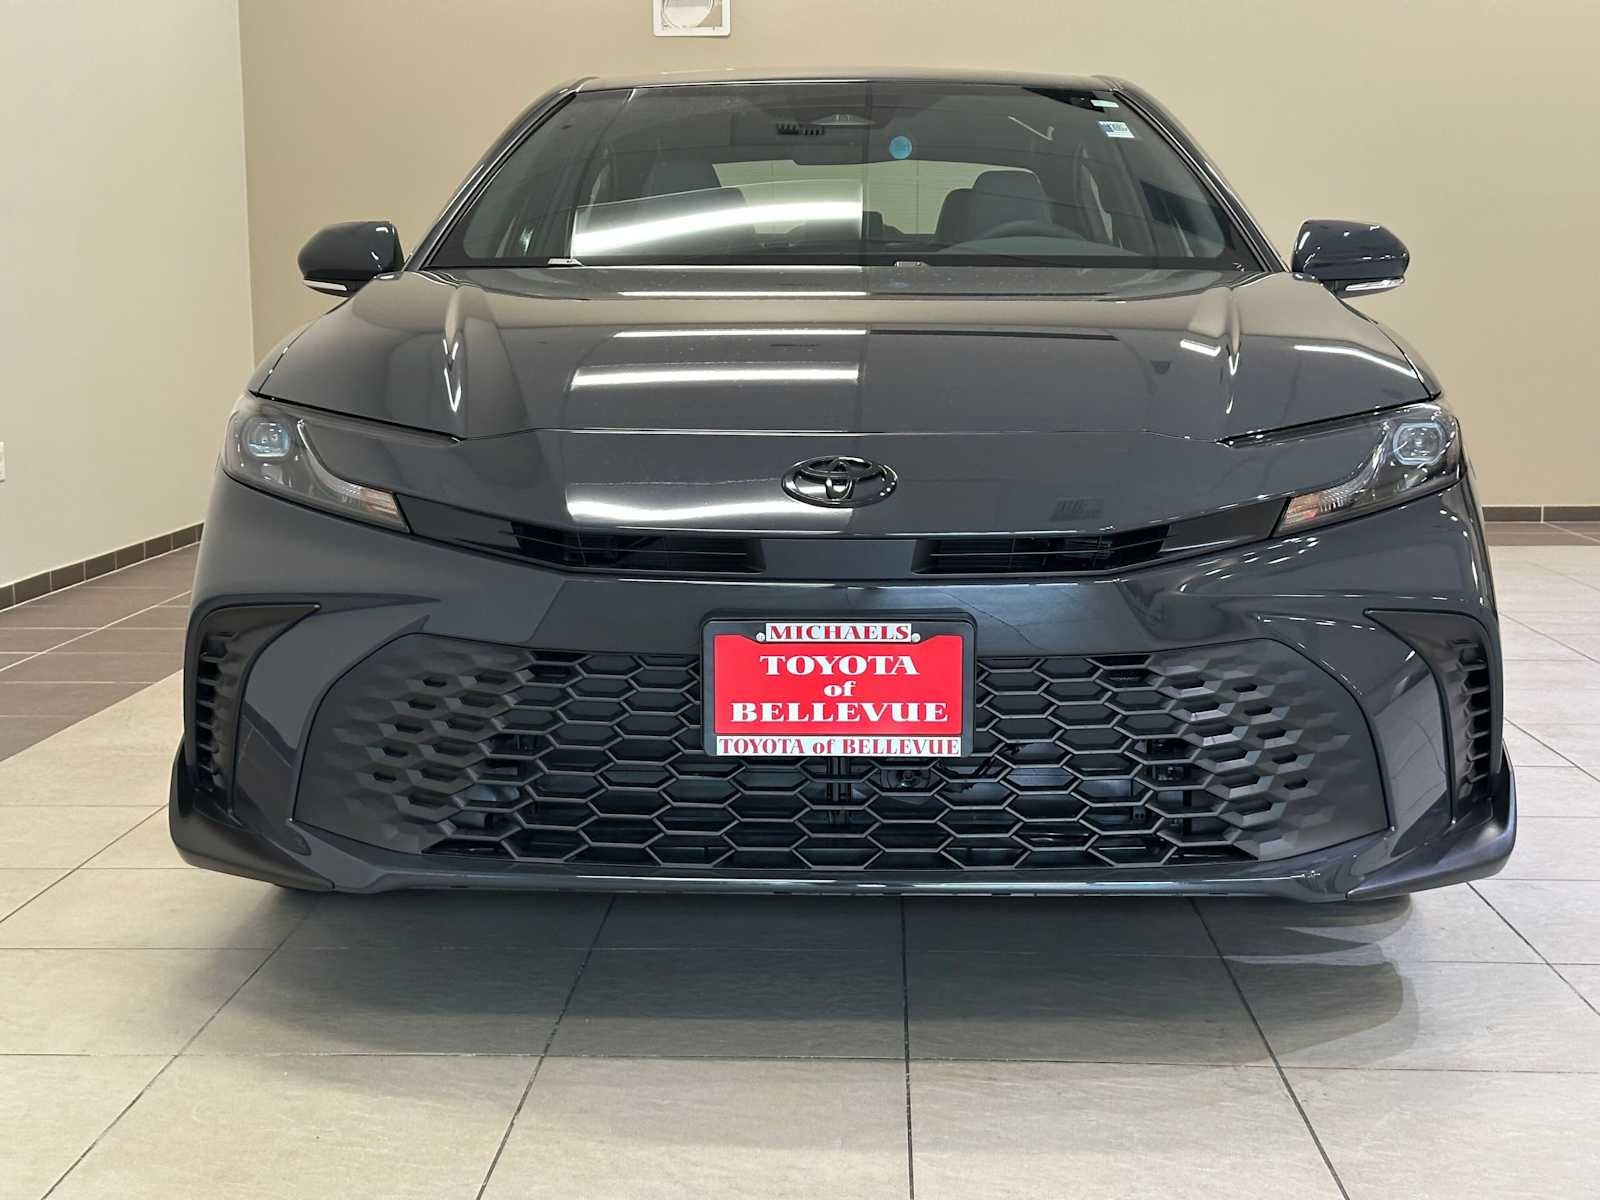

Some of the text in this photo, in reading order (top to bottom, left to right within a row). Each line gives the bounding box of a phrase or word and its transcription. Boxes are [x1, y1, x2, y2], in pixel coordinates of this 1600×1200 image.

[769, 624, 910, 640] MICHAELS
[759, 655, 920, 676] TOYOTA
[823, 680, 857, 697] of
[730, 702, 949, 722] BELLEVUE
[718, 737, 959, 755] TOYOTA of BELLEVUE
